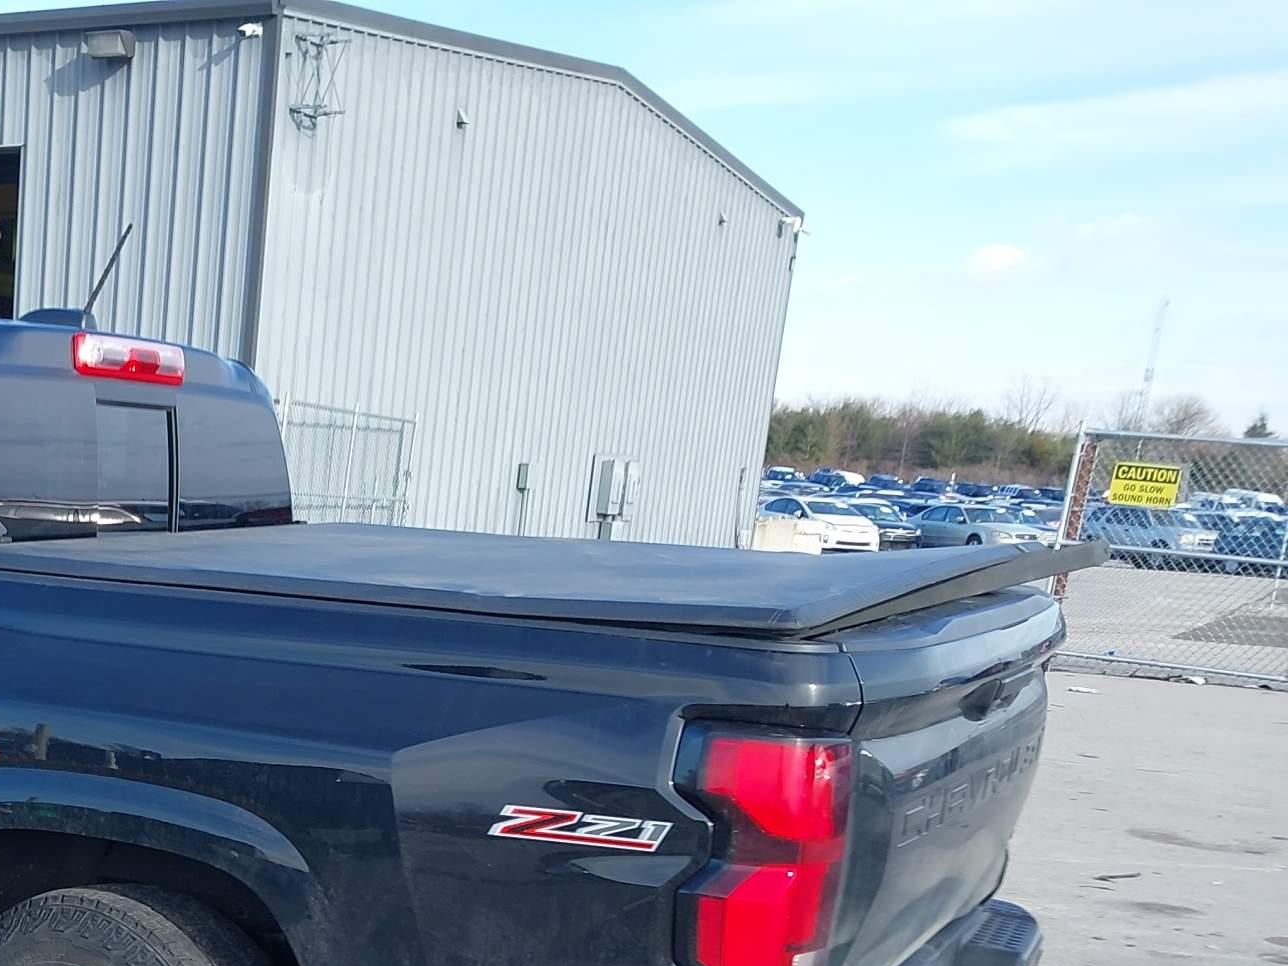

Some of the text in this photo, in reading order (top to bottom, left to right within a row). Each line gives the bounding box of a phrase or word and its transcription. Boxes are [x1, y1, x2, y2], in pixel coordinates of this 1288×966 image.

[1118, 466, 1177, 482] CAUTION
[1123, 484, 1165, 494] GO SLOW
[1112, 493, 1172, 505] SOUND HORN
[487, 804, 674, 853] Z71
